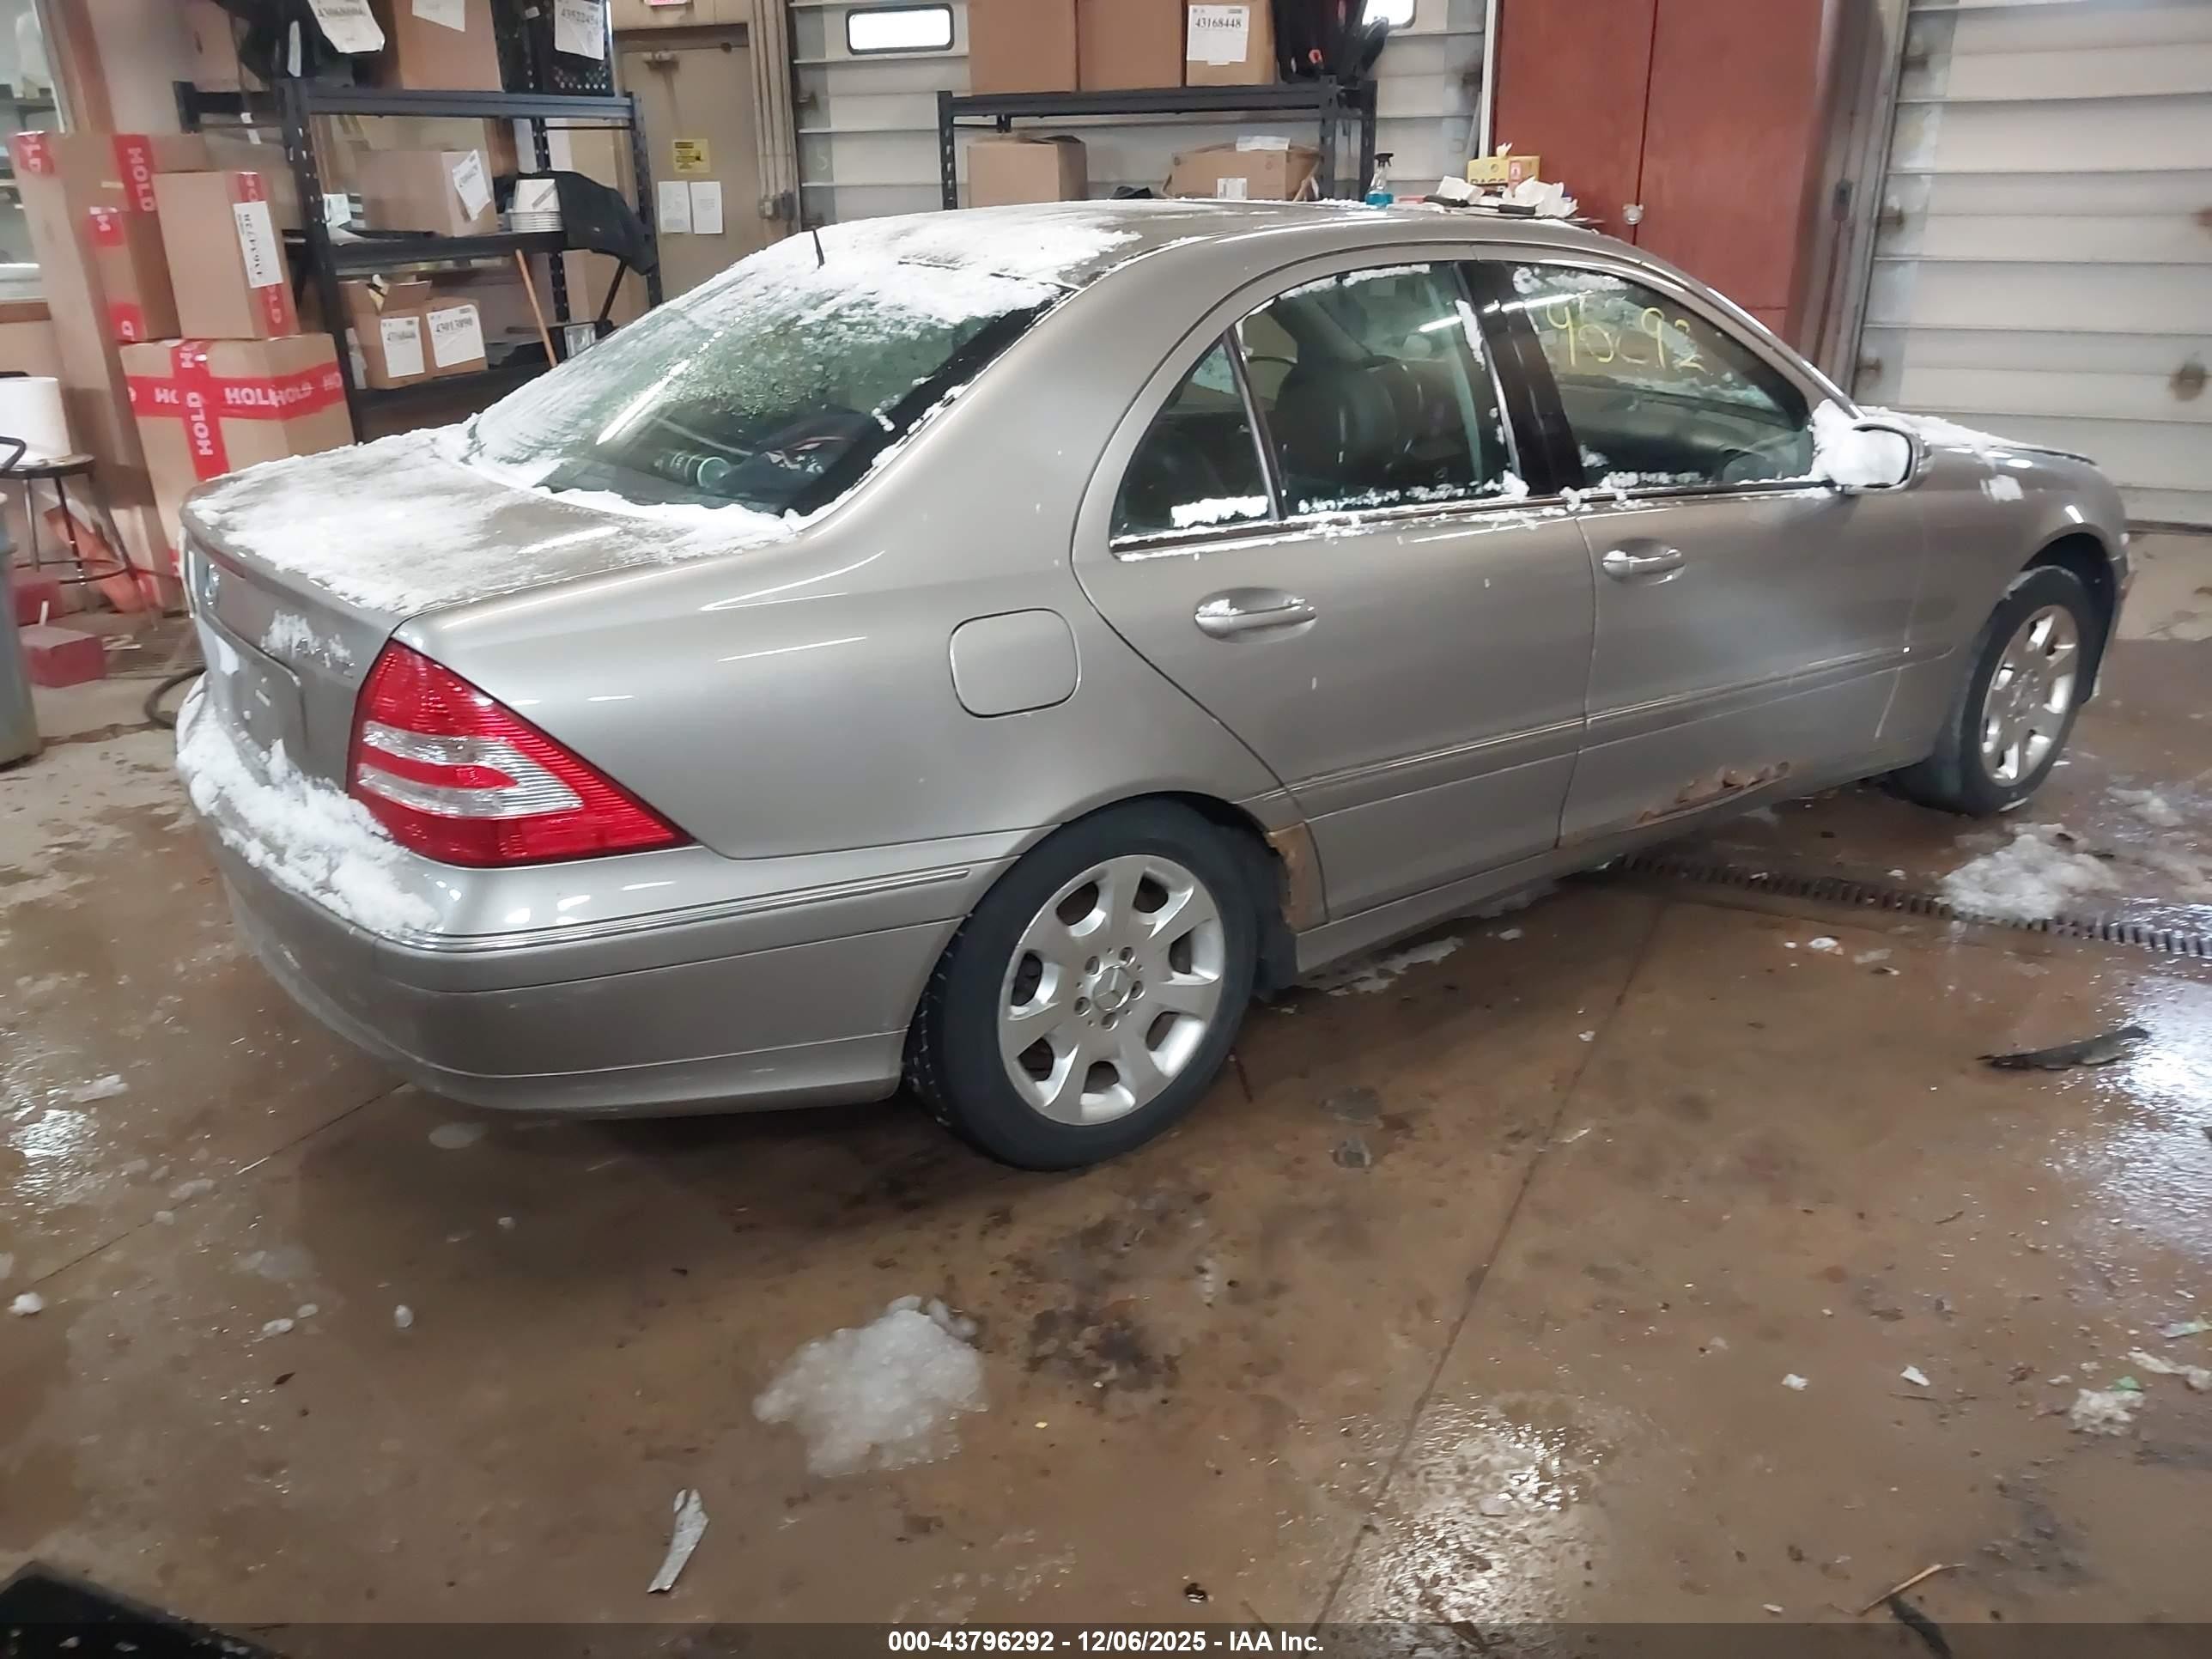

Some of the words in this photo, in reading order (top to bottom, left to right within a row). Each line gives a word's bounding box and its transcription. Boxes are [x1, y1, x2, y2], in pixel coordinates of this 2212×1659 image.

[1195, 17, 1242, 28] 43168448
[127, 147, 157, 212] HOLD
[186, 392, 214, 457] HOLD
